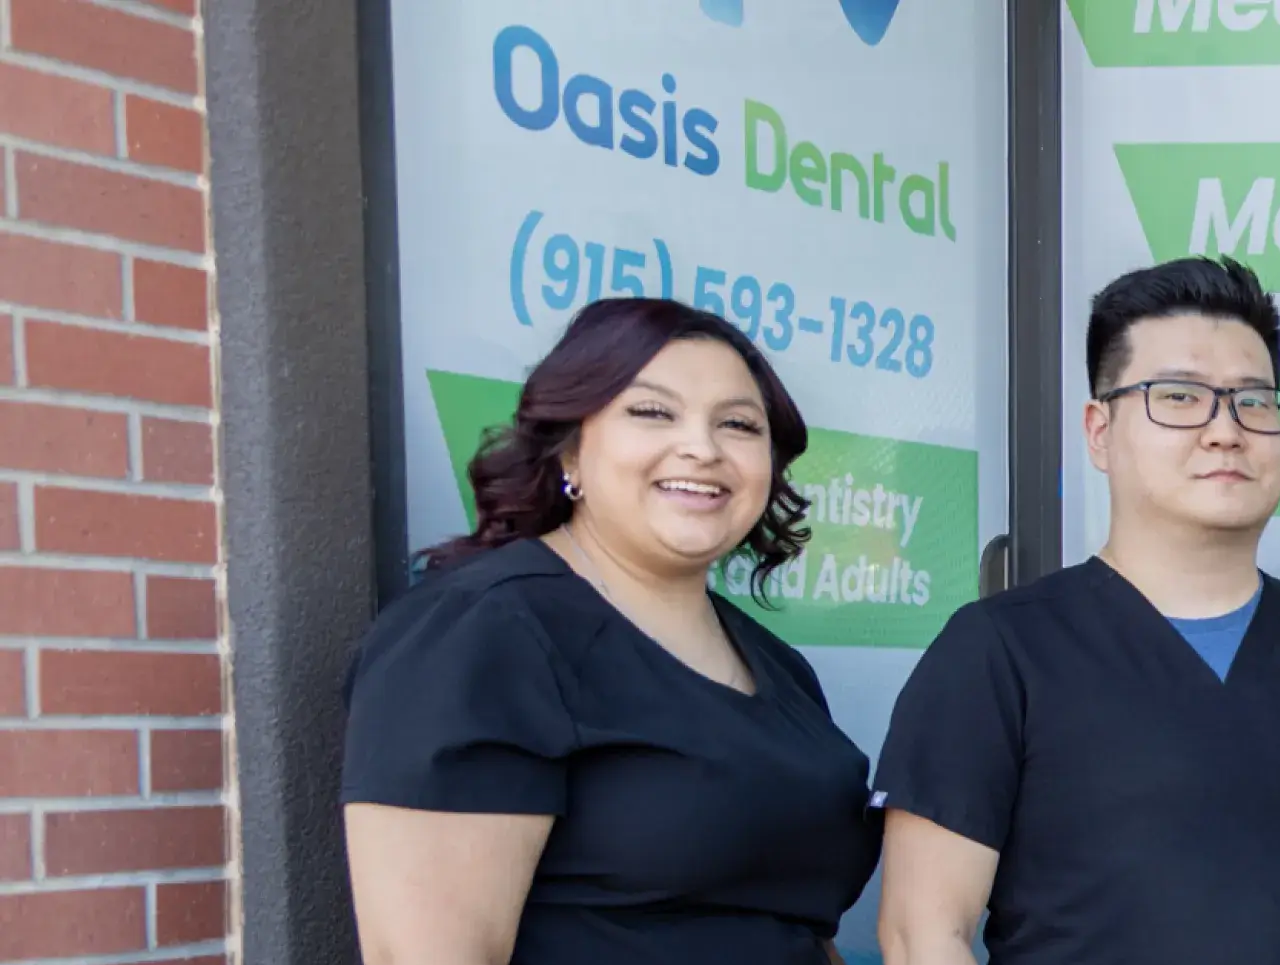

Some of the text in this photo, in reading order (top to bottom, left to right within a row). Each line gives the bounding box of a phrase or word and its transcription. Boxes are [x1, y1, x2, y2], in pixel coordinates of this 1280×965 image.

[492, 24, 957, 243] Oasis Dental
[510, 210, 935, 378] (915) 593-1328
[788, 471, 924, 548] ntistry
[813, 553, 931, 606] Adults
